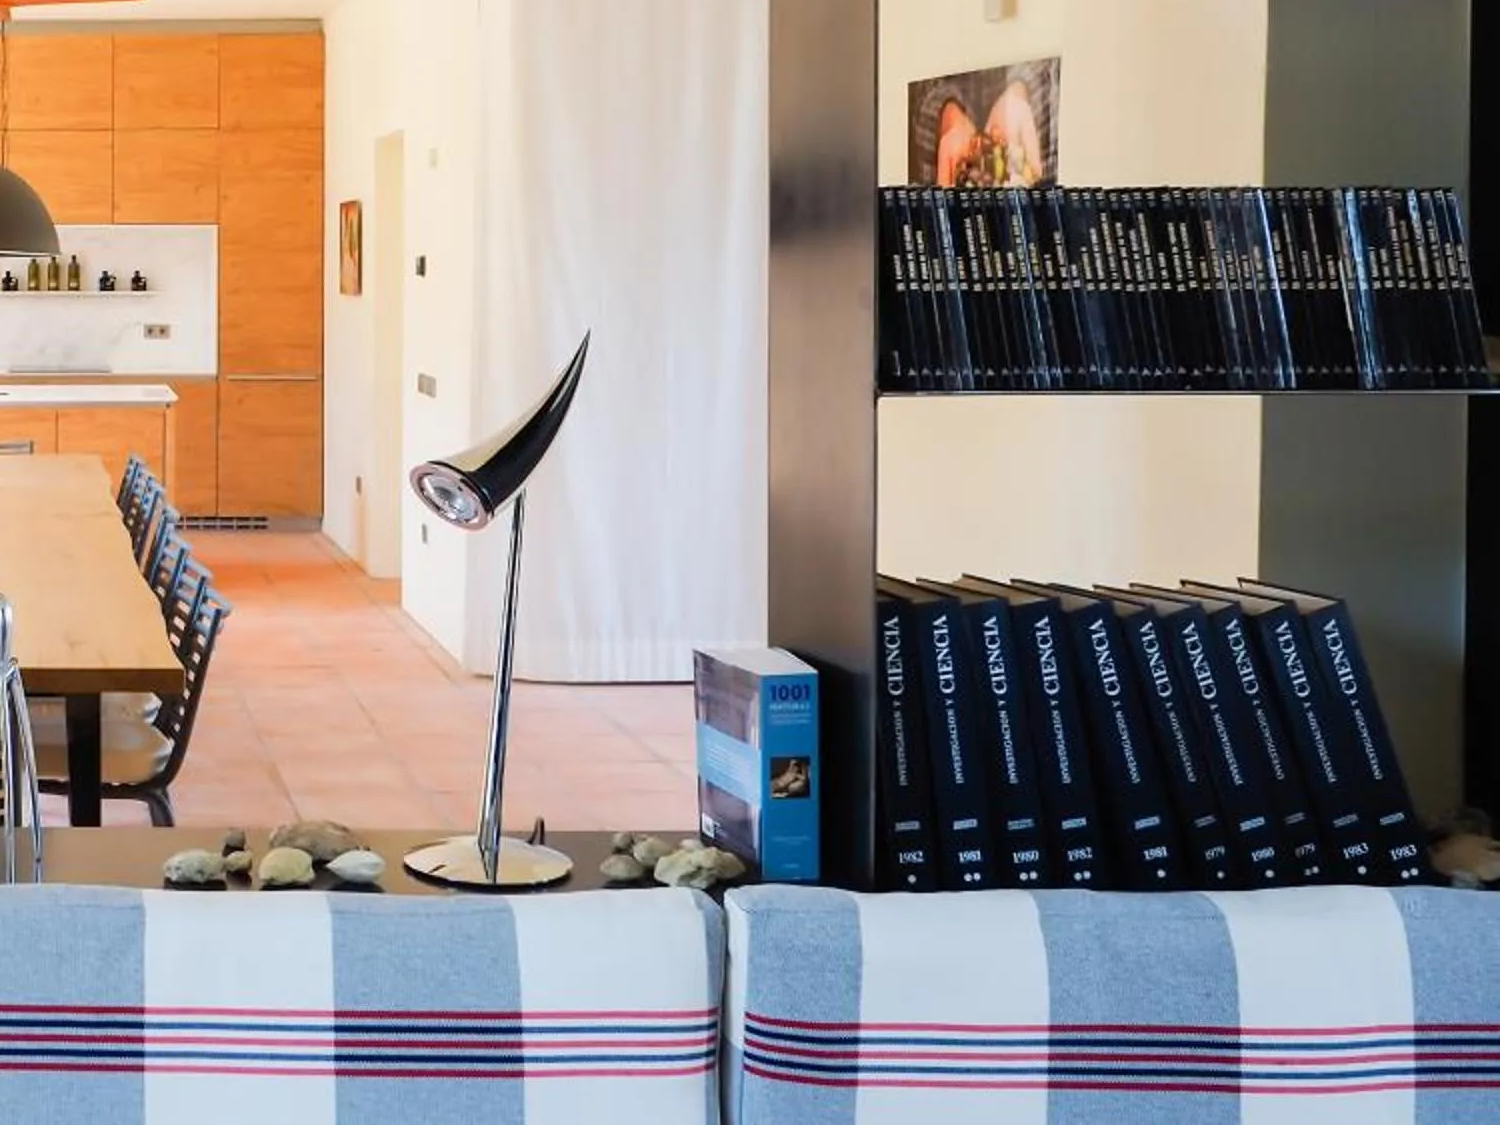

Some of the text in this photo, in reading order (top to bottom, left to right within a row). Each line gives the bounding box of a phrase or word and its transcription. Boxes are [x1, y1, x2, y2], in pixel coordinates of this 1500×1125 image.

[769, 684, 811, 701] 1001
[884, 616, 904, 696] CIENCIA
[932, 614, 956, 695] CIENCIA
[984, 616, 1008, 695] CIENCIA
[1034, 616, 1061, 696] CIENCIA
[1089, 618, 1122, 697] CIENCIA
[1140, 620, 1173, 697] CIENCIA
[1181, 622, 1217, 700] CIENCIA
[1225, 618, 1260, 695] CIENCIA
[1275, 620, 1311, 698] CIENCIA
[1321, 618, 1358, 696] CIENCIA
[958, 850, 982, 864] 1981
[1143, 846, 1168, 861] 1981
[1343, 842, 1370, 859] 1983
[1391, 844, 1417, 860] 1983
